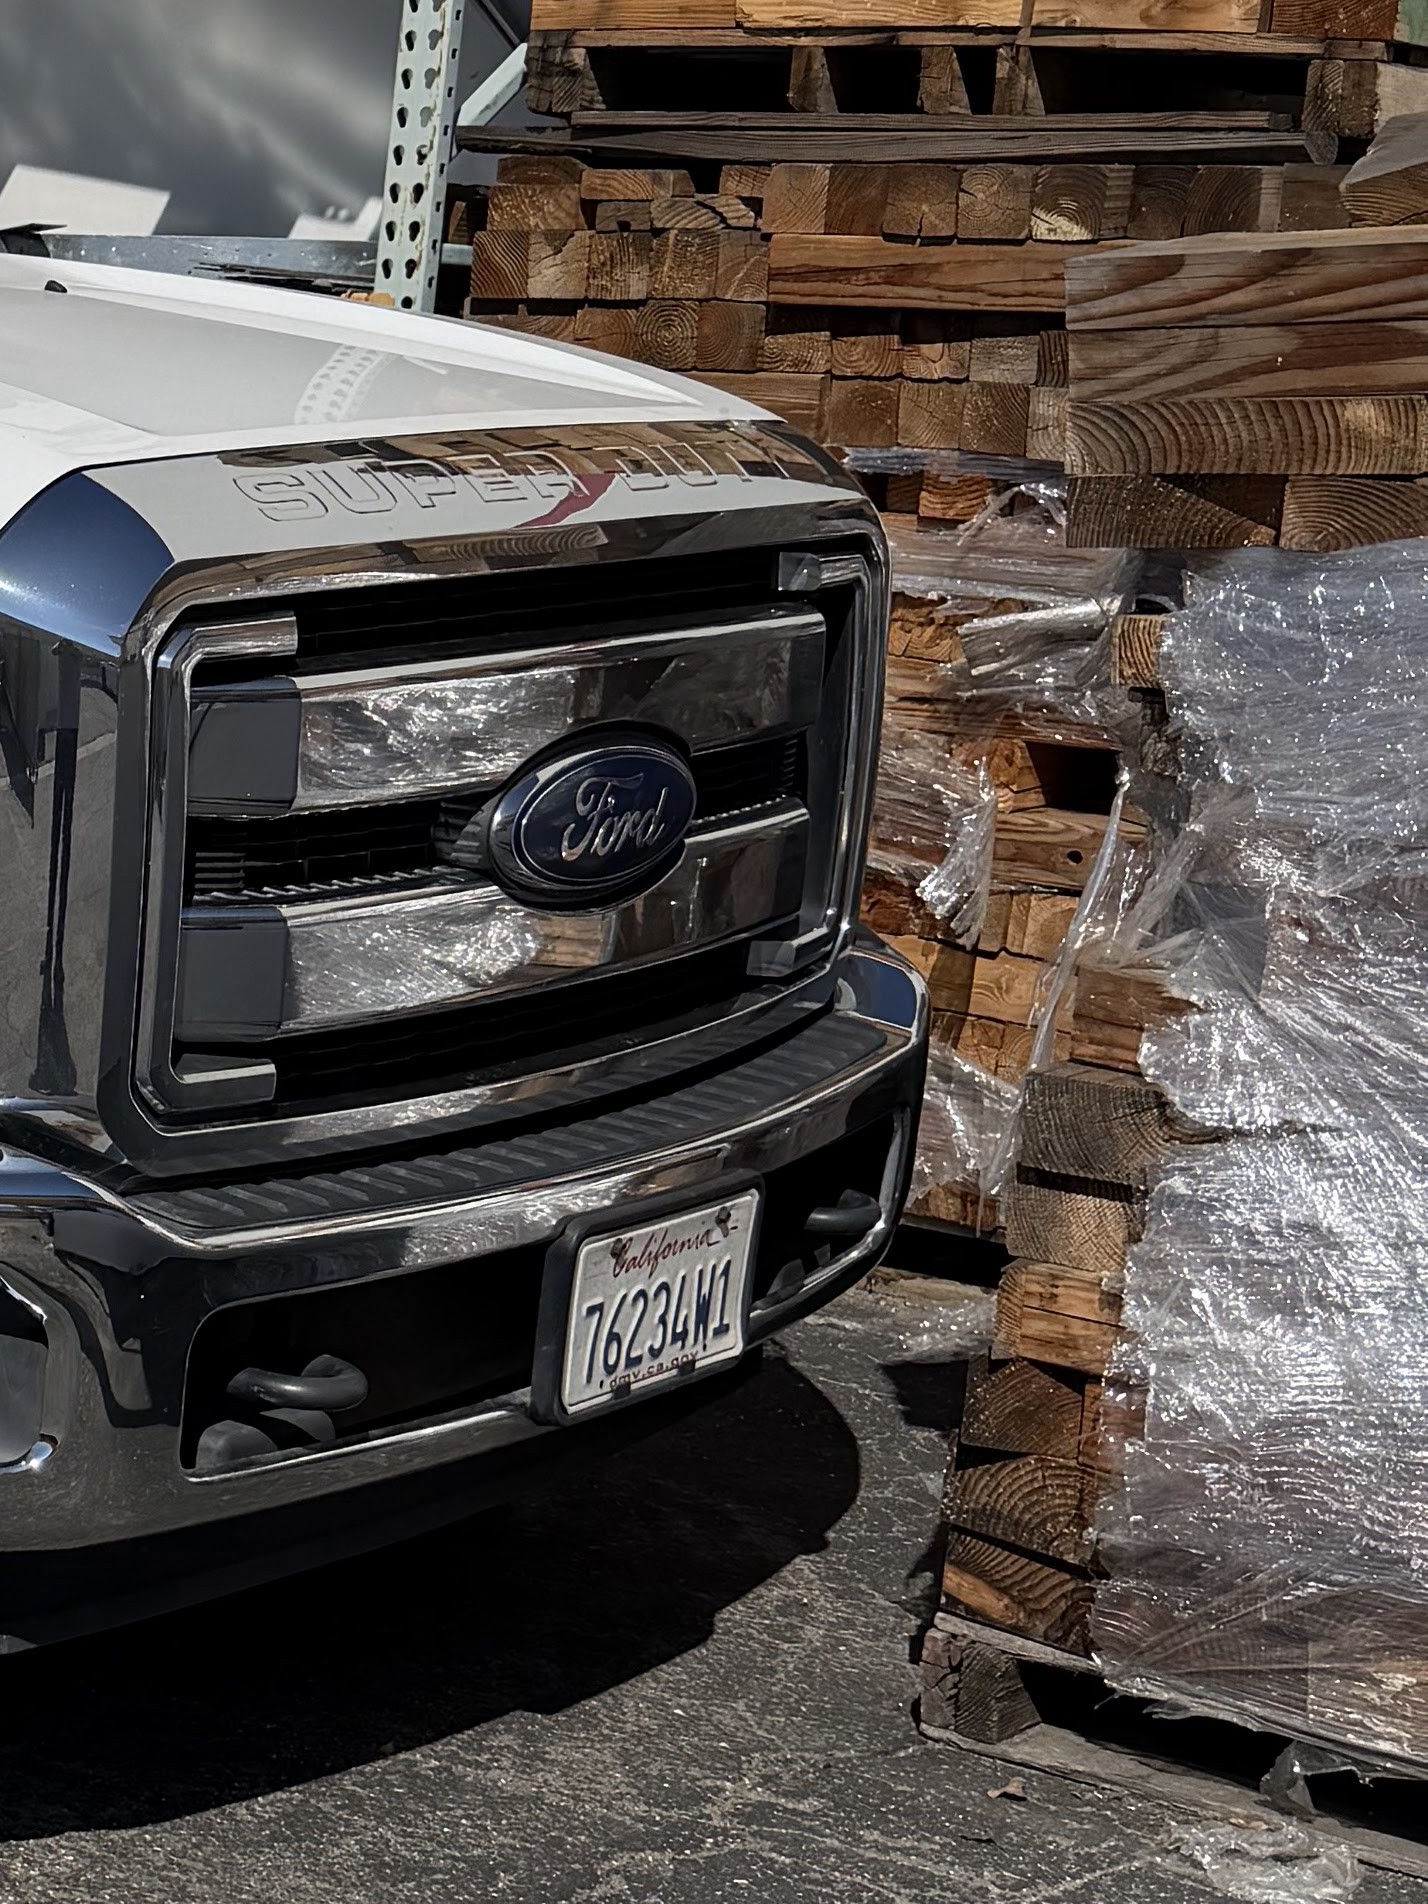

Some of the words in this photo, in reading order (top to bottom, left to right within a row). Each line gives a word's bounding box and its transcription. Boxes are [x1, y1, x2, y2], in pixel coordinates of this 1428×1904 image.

[231, 450, 590, 522] SUPER
[612, 440, 791, 491] DUTY
[561, 772, 670, 862] Ford
[610, 1228, 720, 1279] California
[582, 1258, 732, 1385] 76234W1
[608, 1348, 700, 1390] dmv.ca.gov
